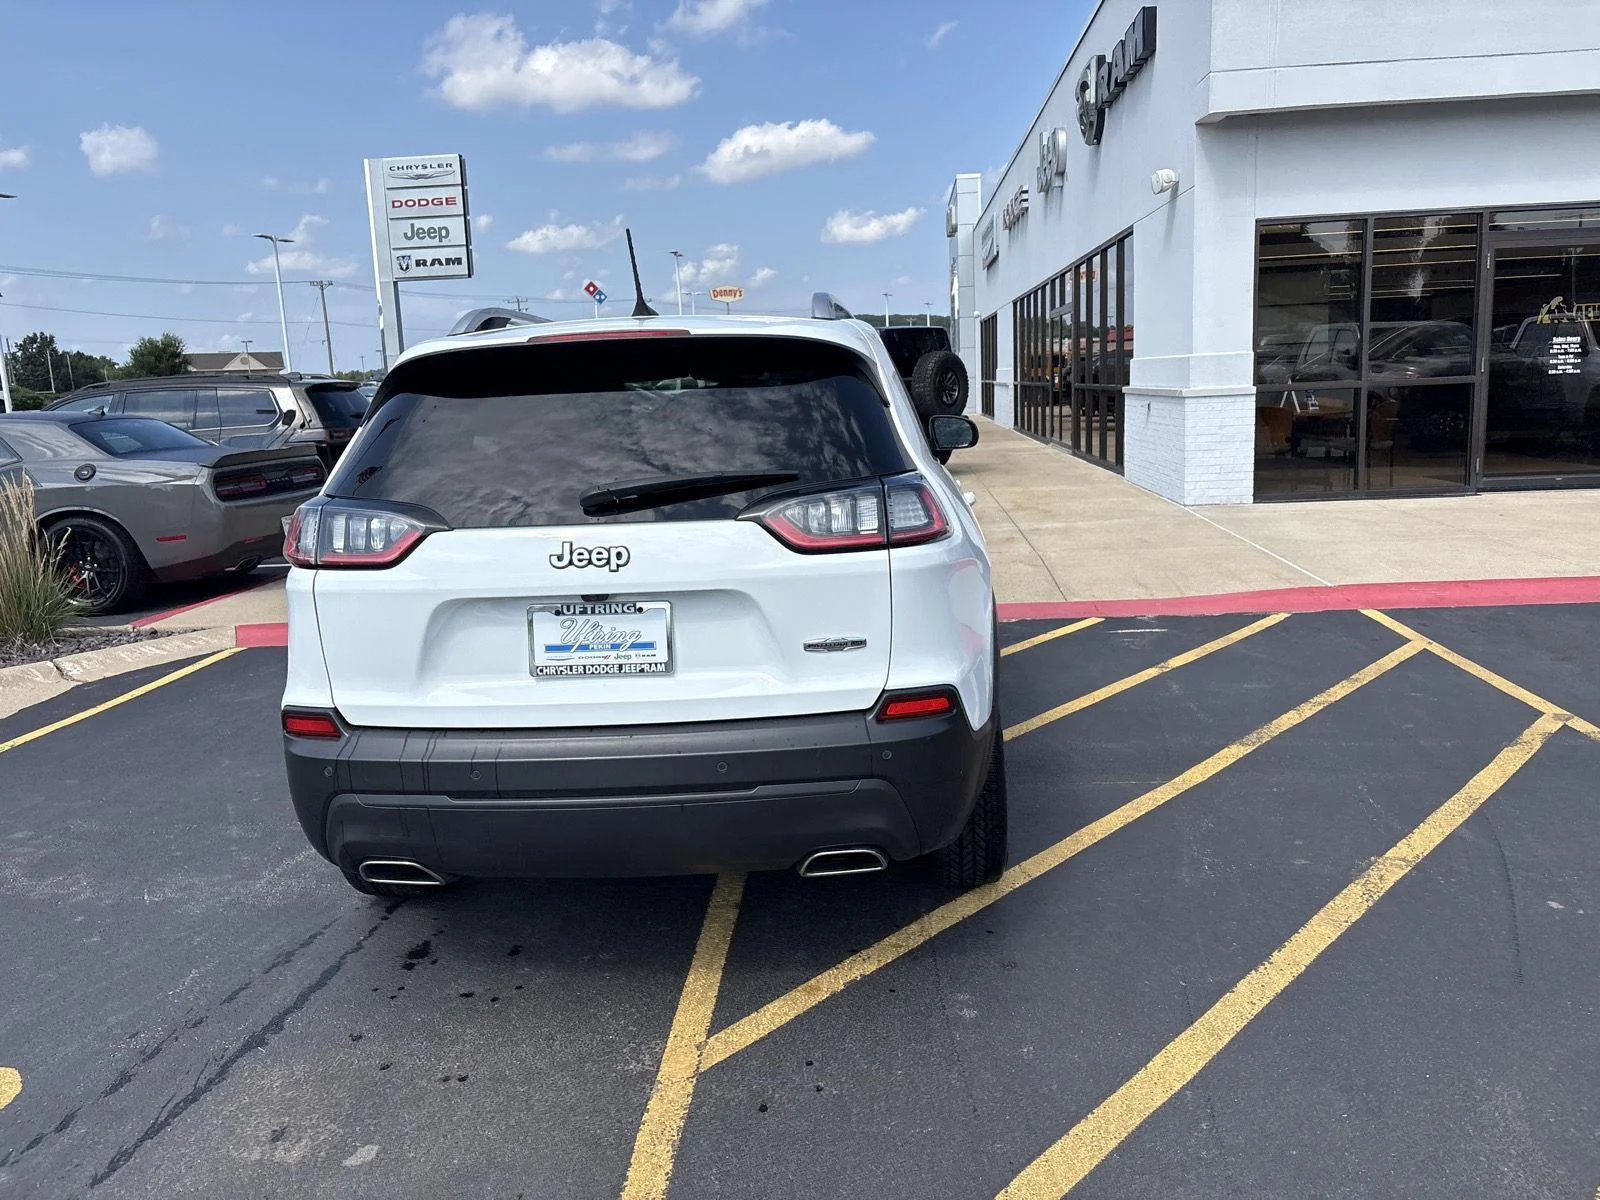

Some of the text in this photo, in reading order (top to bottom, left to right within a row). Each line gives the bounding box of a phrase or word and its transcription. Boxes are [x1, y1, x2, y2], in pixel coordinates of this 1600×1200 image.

[1097, 6, 1157, 108] RAM
[389, 163, 453, 171] CHRYSLER
[392, 197, 457, 208] DODGE
[403, 223, 450, 242] Jeep
[415, 257, 463, 267] RAM
[712, 288, 743, 299] Denny's
[549, 541, 631, 572] Jeep
[563, 604, 635, 614] UFTRING
[537, 666, 584, 675] CHRYSLER
[585, 664, 619, 674] DODGE
